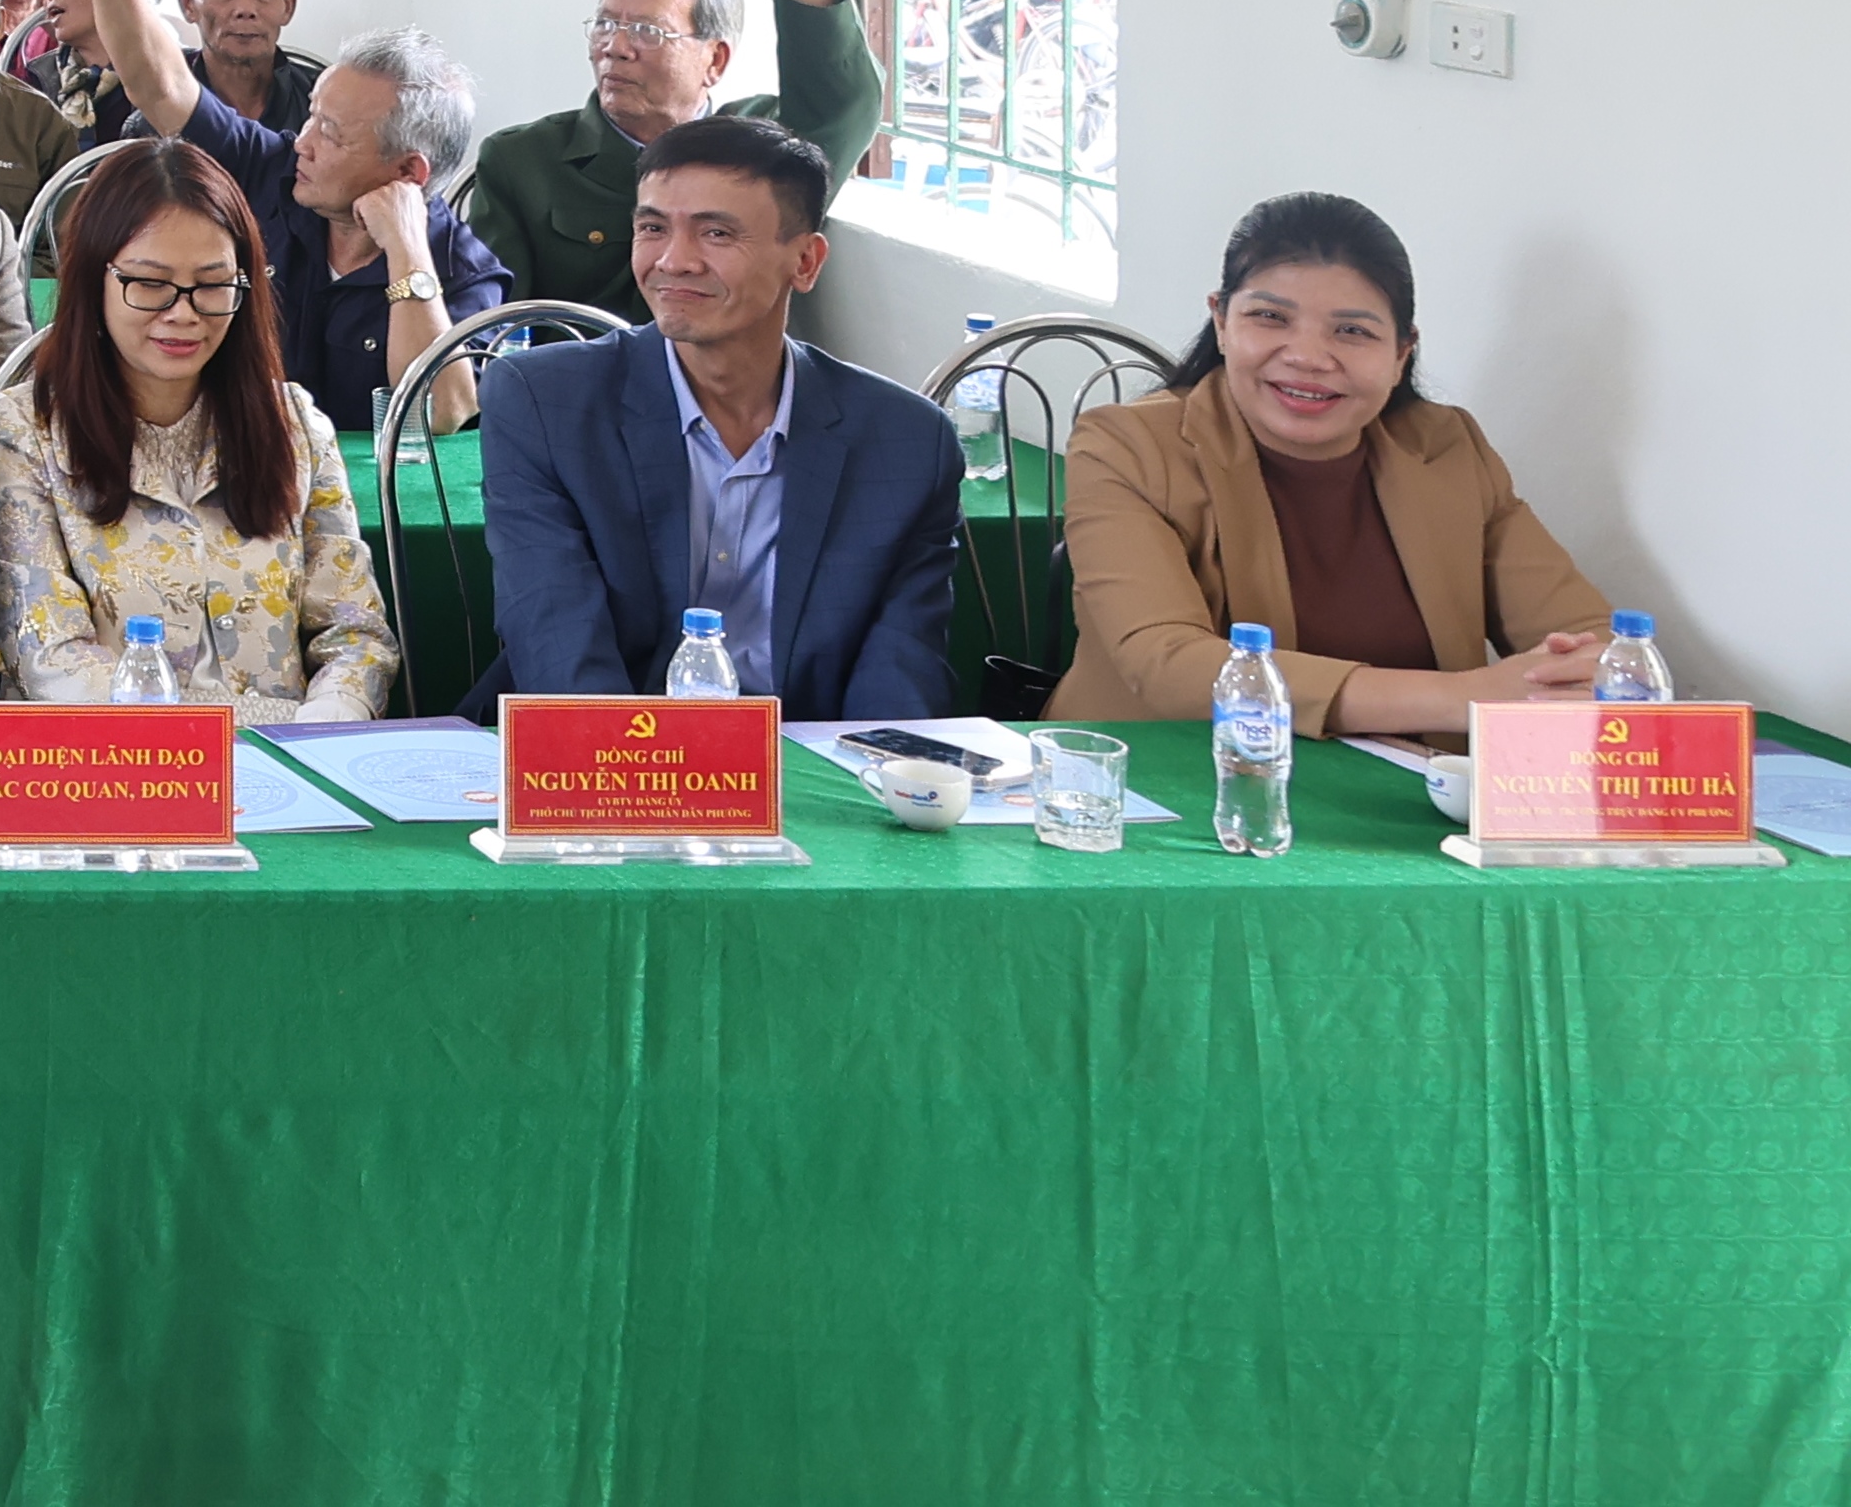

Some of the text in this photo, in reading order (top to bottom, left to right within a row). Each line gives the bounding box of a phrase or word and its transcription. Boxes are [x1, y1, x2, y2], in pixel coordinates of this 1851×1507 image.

[32, 745, 84, 771] DIỆN
[90, 744, 152, 766] LÃNH
[157, 747, 205, 770] ĐẠO
[651, 746, 685, 765] CHÍ
[1625, 748, 1660, 767] CHÍ
[25, 778, 60, 800] CƠ
[63, 780, 136, 804] QUAN,
[141, 778, 192, 800] ĐƠN
[195, 780, 220, 804] VỊ
[522, 767, 627, 792] NGUYỄN
[634, 771, 680, 797] THỊ
[685, 771, 758, 792] OANH
[1598, 774, 1641, 800] THỊ
[1645, 775, 1698, 796] THU
[1702, 772, 1738, 797] HÀ
